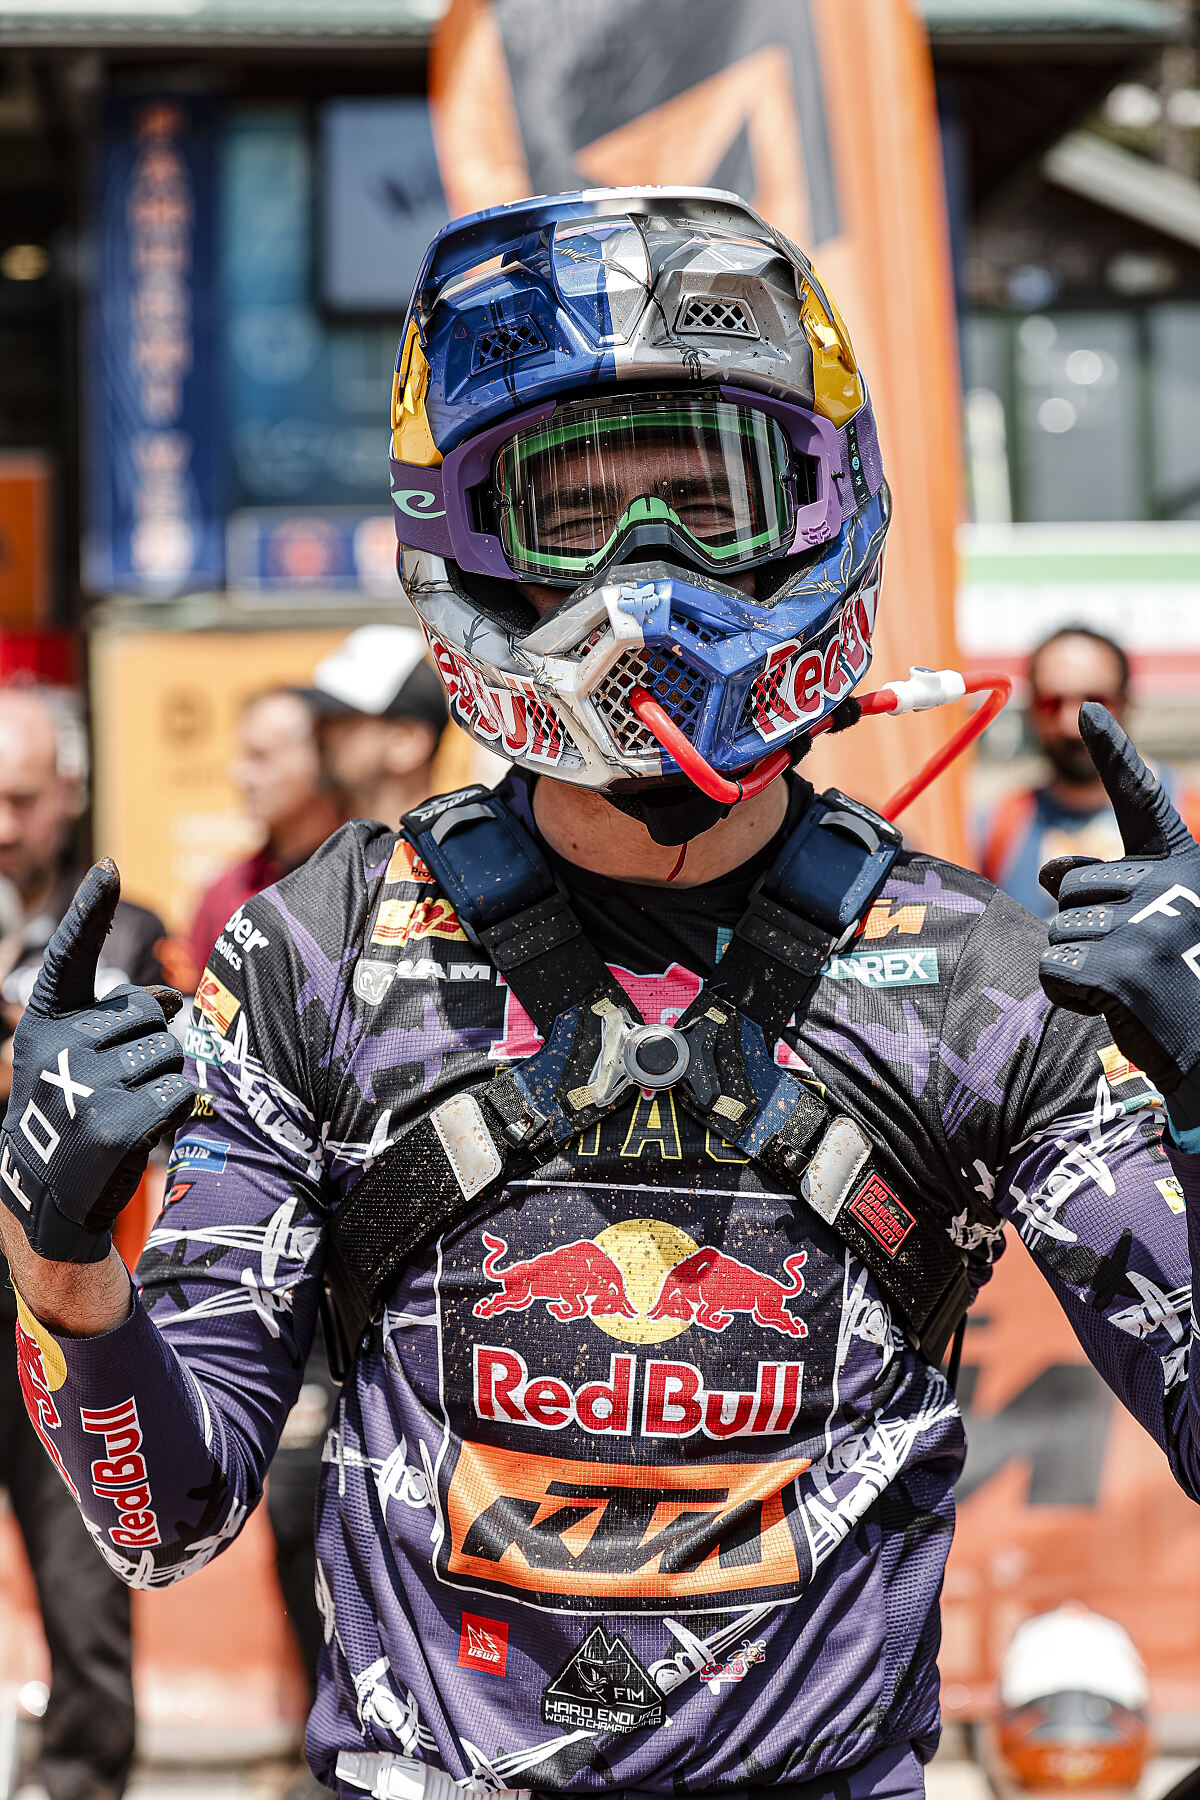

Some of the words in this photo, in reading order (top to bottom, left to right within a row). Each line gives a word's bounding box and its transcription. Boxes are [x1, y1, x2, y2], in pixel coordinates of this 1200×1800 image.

[1, 1047, 95, 1212] FOX
[868, 1183, 889, 1202] NO
[856, 1200, 899, 1245] MONKEY
[863, 1192, 906, 1239] DANCING
[460, 1480, 764, 1575] KTM
[544, 1700, 593, 1718] HARD
[613, 1687, 645, 1703] FIM
[544, 1712, 586, 1727] WORLD
